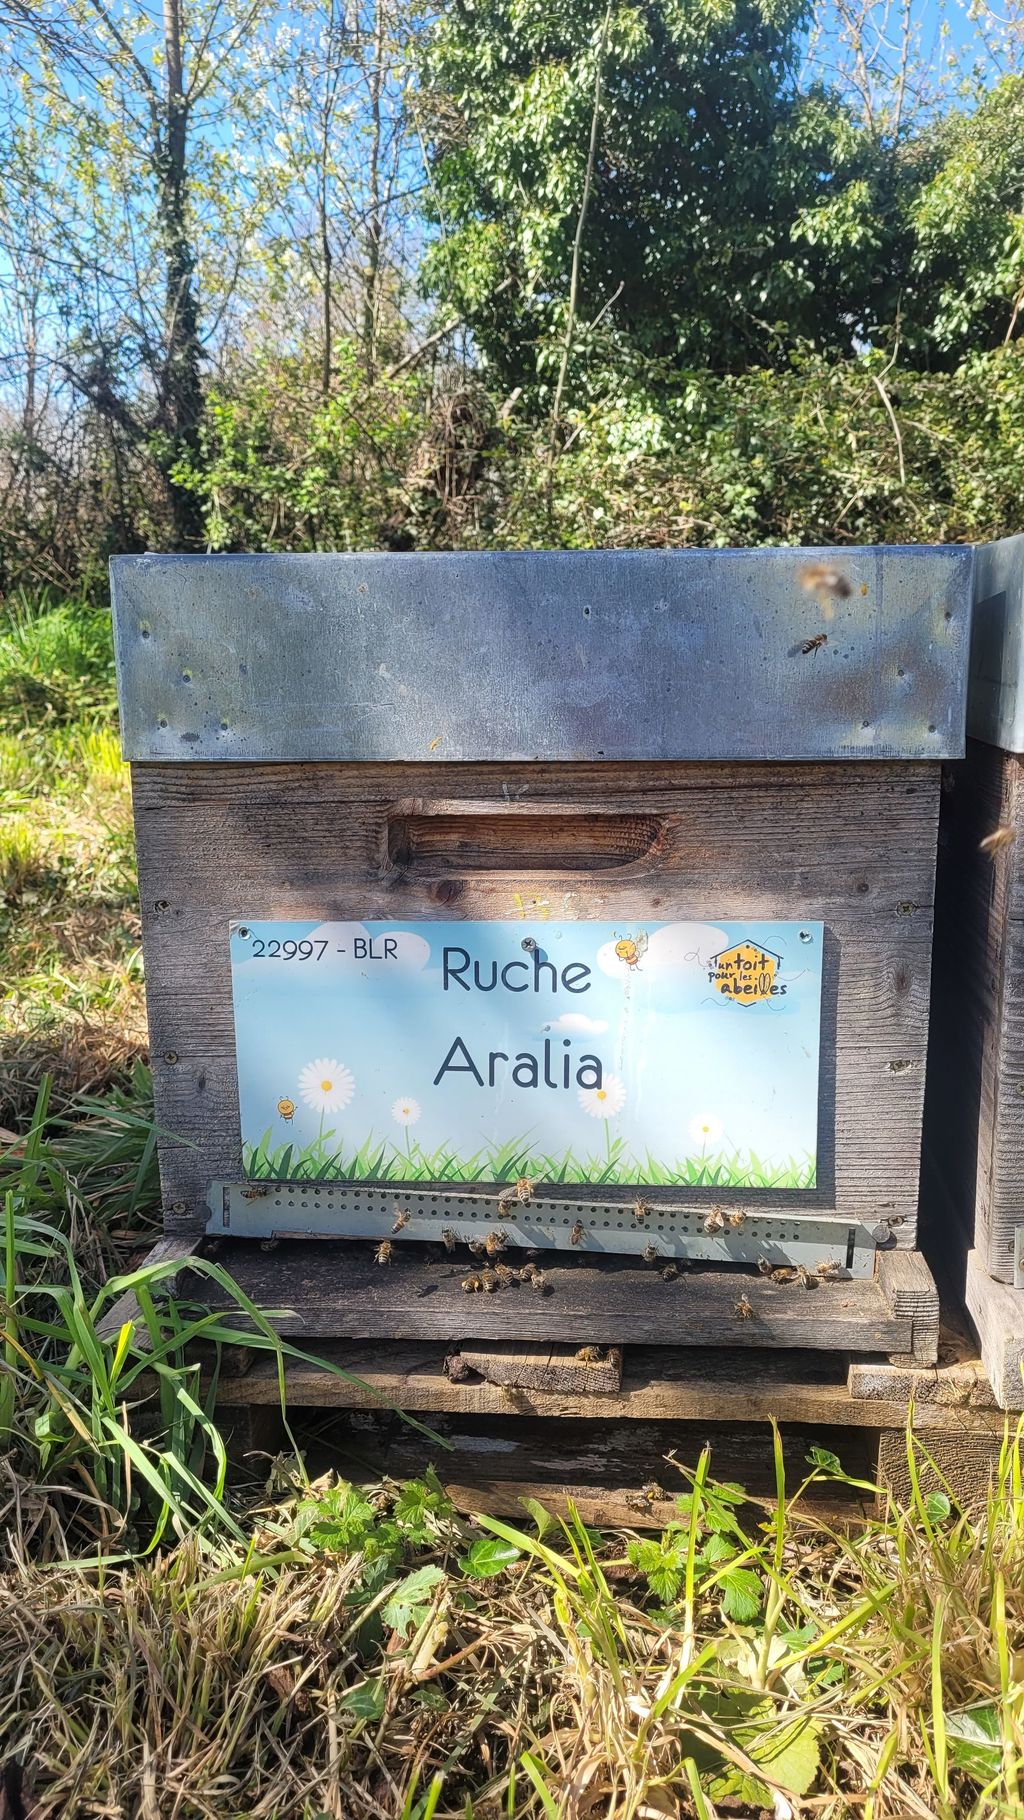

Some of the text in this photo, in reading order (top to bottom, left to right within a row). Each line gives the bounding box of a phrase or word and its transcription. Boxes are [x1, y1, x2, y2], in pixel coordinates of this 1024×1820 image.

[252, 939, 329, 961] 22997
[354, 938, 398, 960] BLR
[442, 945, 592, 994] Ruche
[718, 953, 770, 971] un toit
[708, 971, 752, 983] pour les
[720, 973, 787, 996] abeilles
[433, 1036, 604, 1091] Aralia
